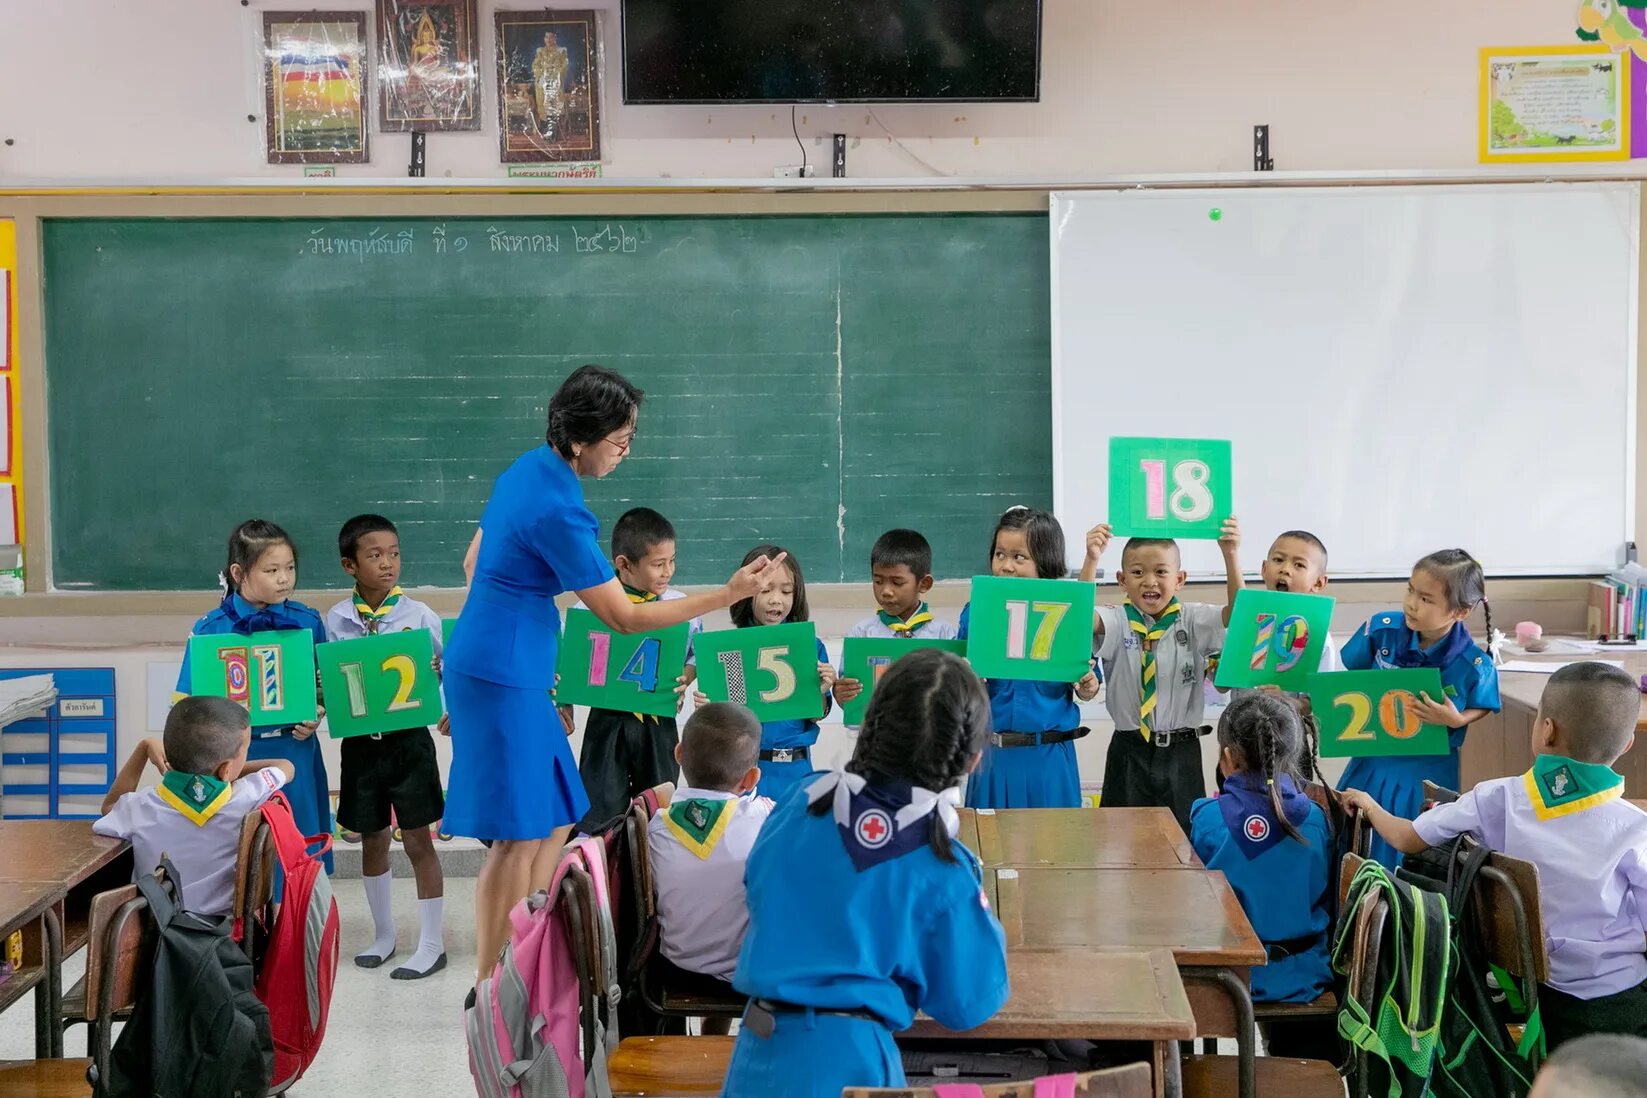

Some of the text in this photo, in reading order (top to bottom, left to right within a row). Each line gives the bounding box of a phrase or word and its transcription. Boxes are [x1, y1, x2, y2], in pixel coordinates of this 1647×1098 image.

[306, 227, 414, 264] วันพฤหัสบดี
[432, 223, 447, 254] ที่
[486, 225, 559, 252] สิงหาคม
[1140, 459, 1214, 522] 18
[1005, 600, 1072, 661] 17
[1250, 613, 1310, 673] 19
[218, 644, 284, 711] 11
[339, 654, 423, 718] 12
[587, 630, 662, 693] 14
[717, 645, 798, 705] 15
[1333, 689, 1422, 741] 20
